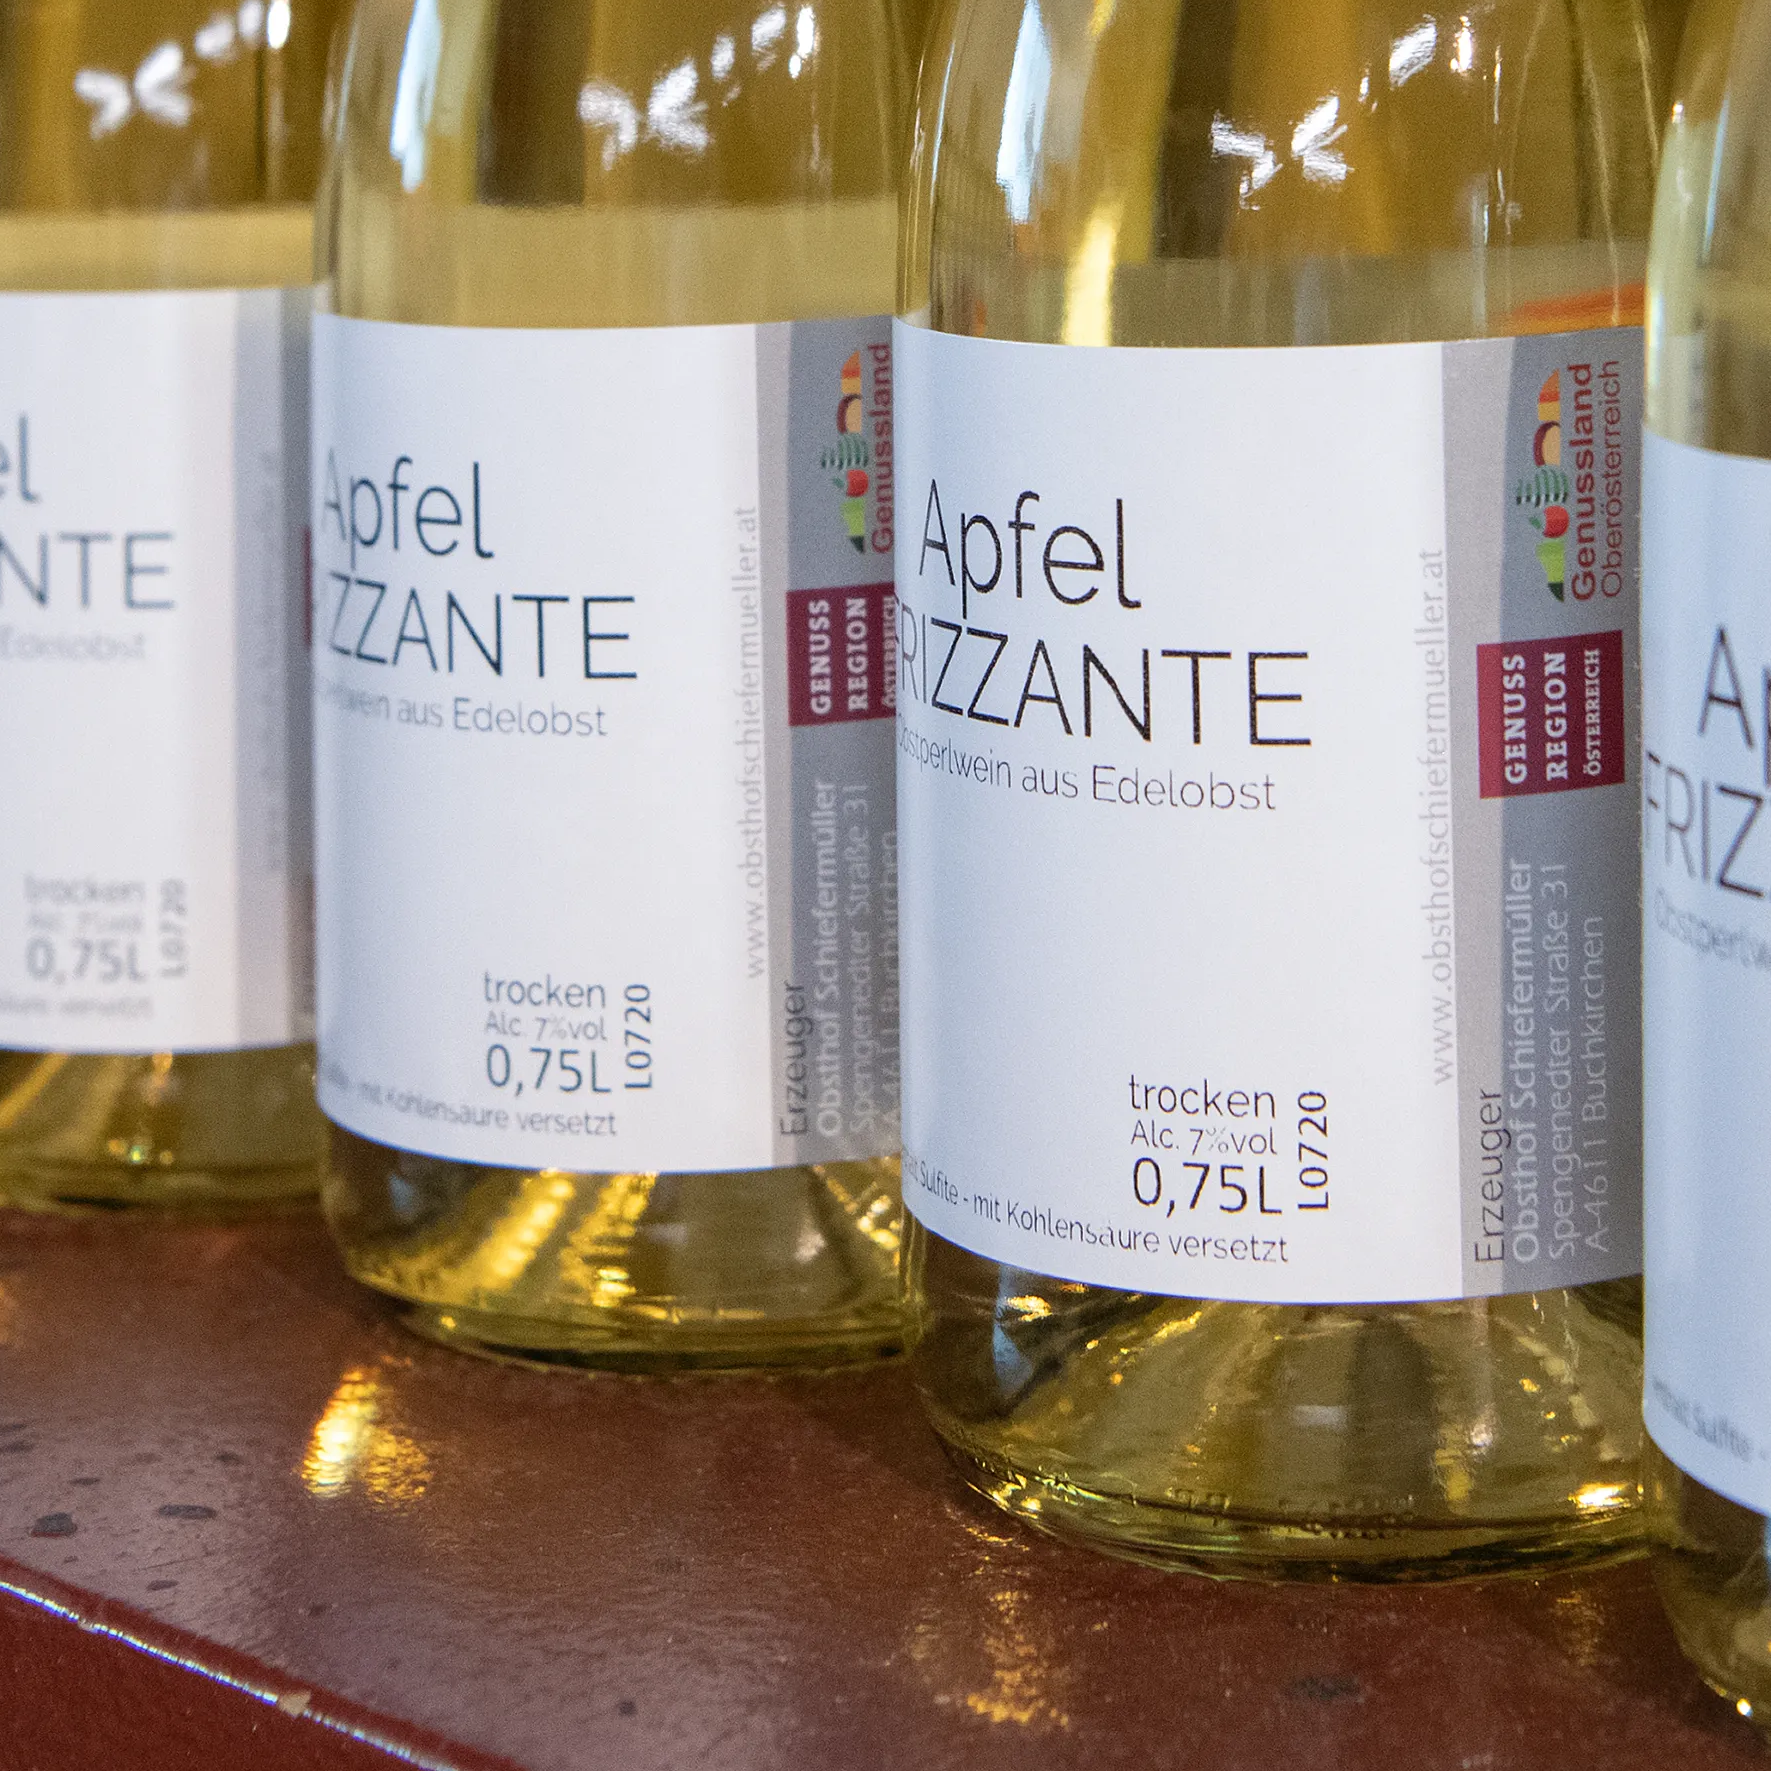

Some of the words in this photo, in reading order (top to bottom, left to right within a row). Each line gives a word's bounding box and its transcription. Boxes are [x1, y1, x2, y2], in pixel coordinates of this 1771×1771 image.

[867, 340, 894, 554] Genussland
[1568, 361, 1597, 601] Genussland
[1599, 358, 1626, 598] Oberösterreich
[321, 446, 495, 572] Apfel
[918, 477, 1142, 620] Apfel
[327, 570, 638, 681] ZZANTE
[807, 597, 832, 714] GENUSS
[845, 596, 869, 710] REGION
[396, 696, 444, 728] aus
[452, 695, 609, 737] Edelobst
[1502, 653, 1529, 784] GENUSS
[1544, 650, 1570, 780] REGION
[1582, 646, 1603, 775] ÖSTERREICH
[1021, 765, 1079, 799] aus
[1092, 764, 1277, 812] Edelobst
[1412, 548, 1454, 1083] www.obsthofschiefermueller.at
[1539, 861, 1569, 899] 31
[484, 969, 607, 1010] trocken
[1504, 855, 1538, 1109] Schiefermüller
[1540, 908, 1571, 1012] Straße
[1579, 914, 1609, 1122] Buchkirchen
[485, 1042, 613, 1098] 0,75L
[622, 983, 654, 1091] L0720
[779, 978, 813, 1136] Erzeuger
[1128, 1074, 1276, 1120] trocken
[1130, 1119, 1180, 1151] Alc.
[1132, 1157, 1283, 1218] 0,75L
[1296, 1091, 1330, 1213] L0720
[1473, 1086, 1512, 1263] Erzeuger
[1508, 1116, 1541, 1263] Obsthof
[1543, 1025, 1582, 1258] Spengenedter
[1582, 1136, 1610, 1252] A-4611
[920, 1160, 959, 1207] Sulfite
[972, 1189, 1002, 1224] mit
[1007, 1199, 1161, 1254] Kohlensäure
[1168, 1230, 1290, 1265] versetzt
